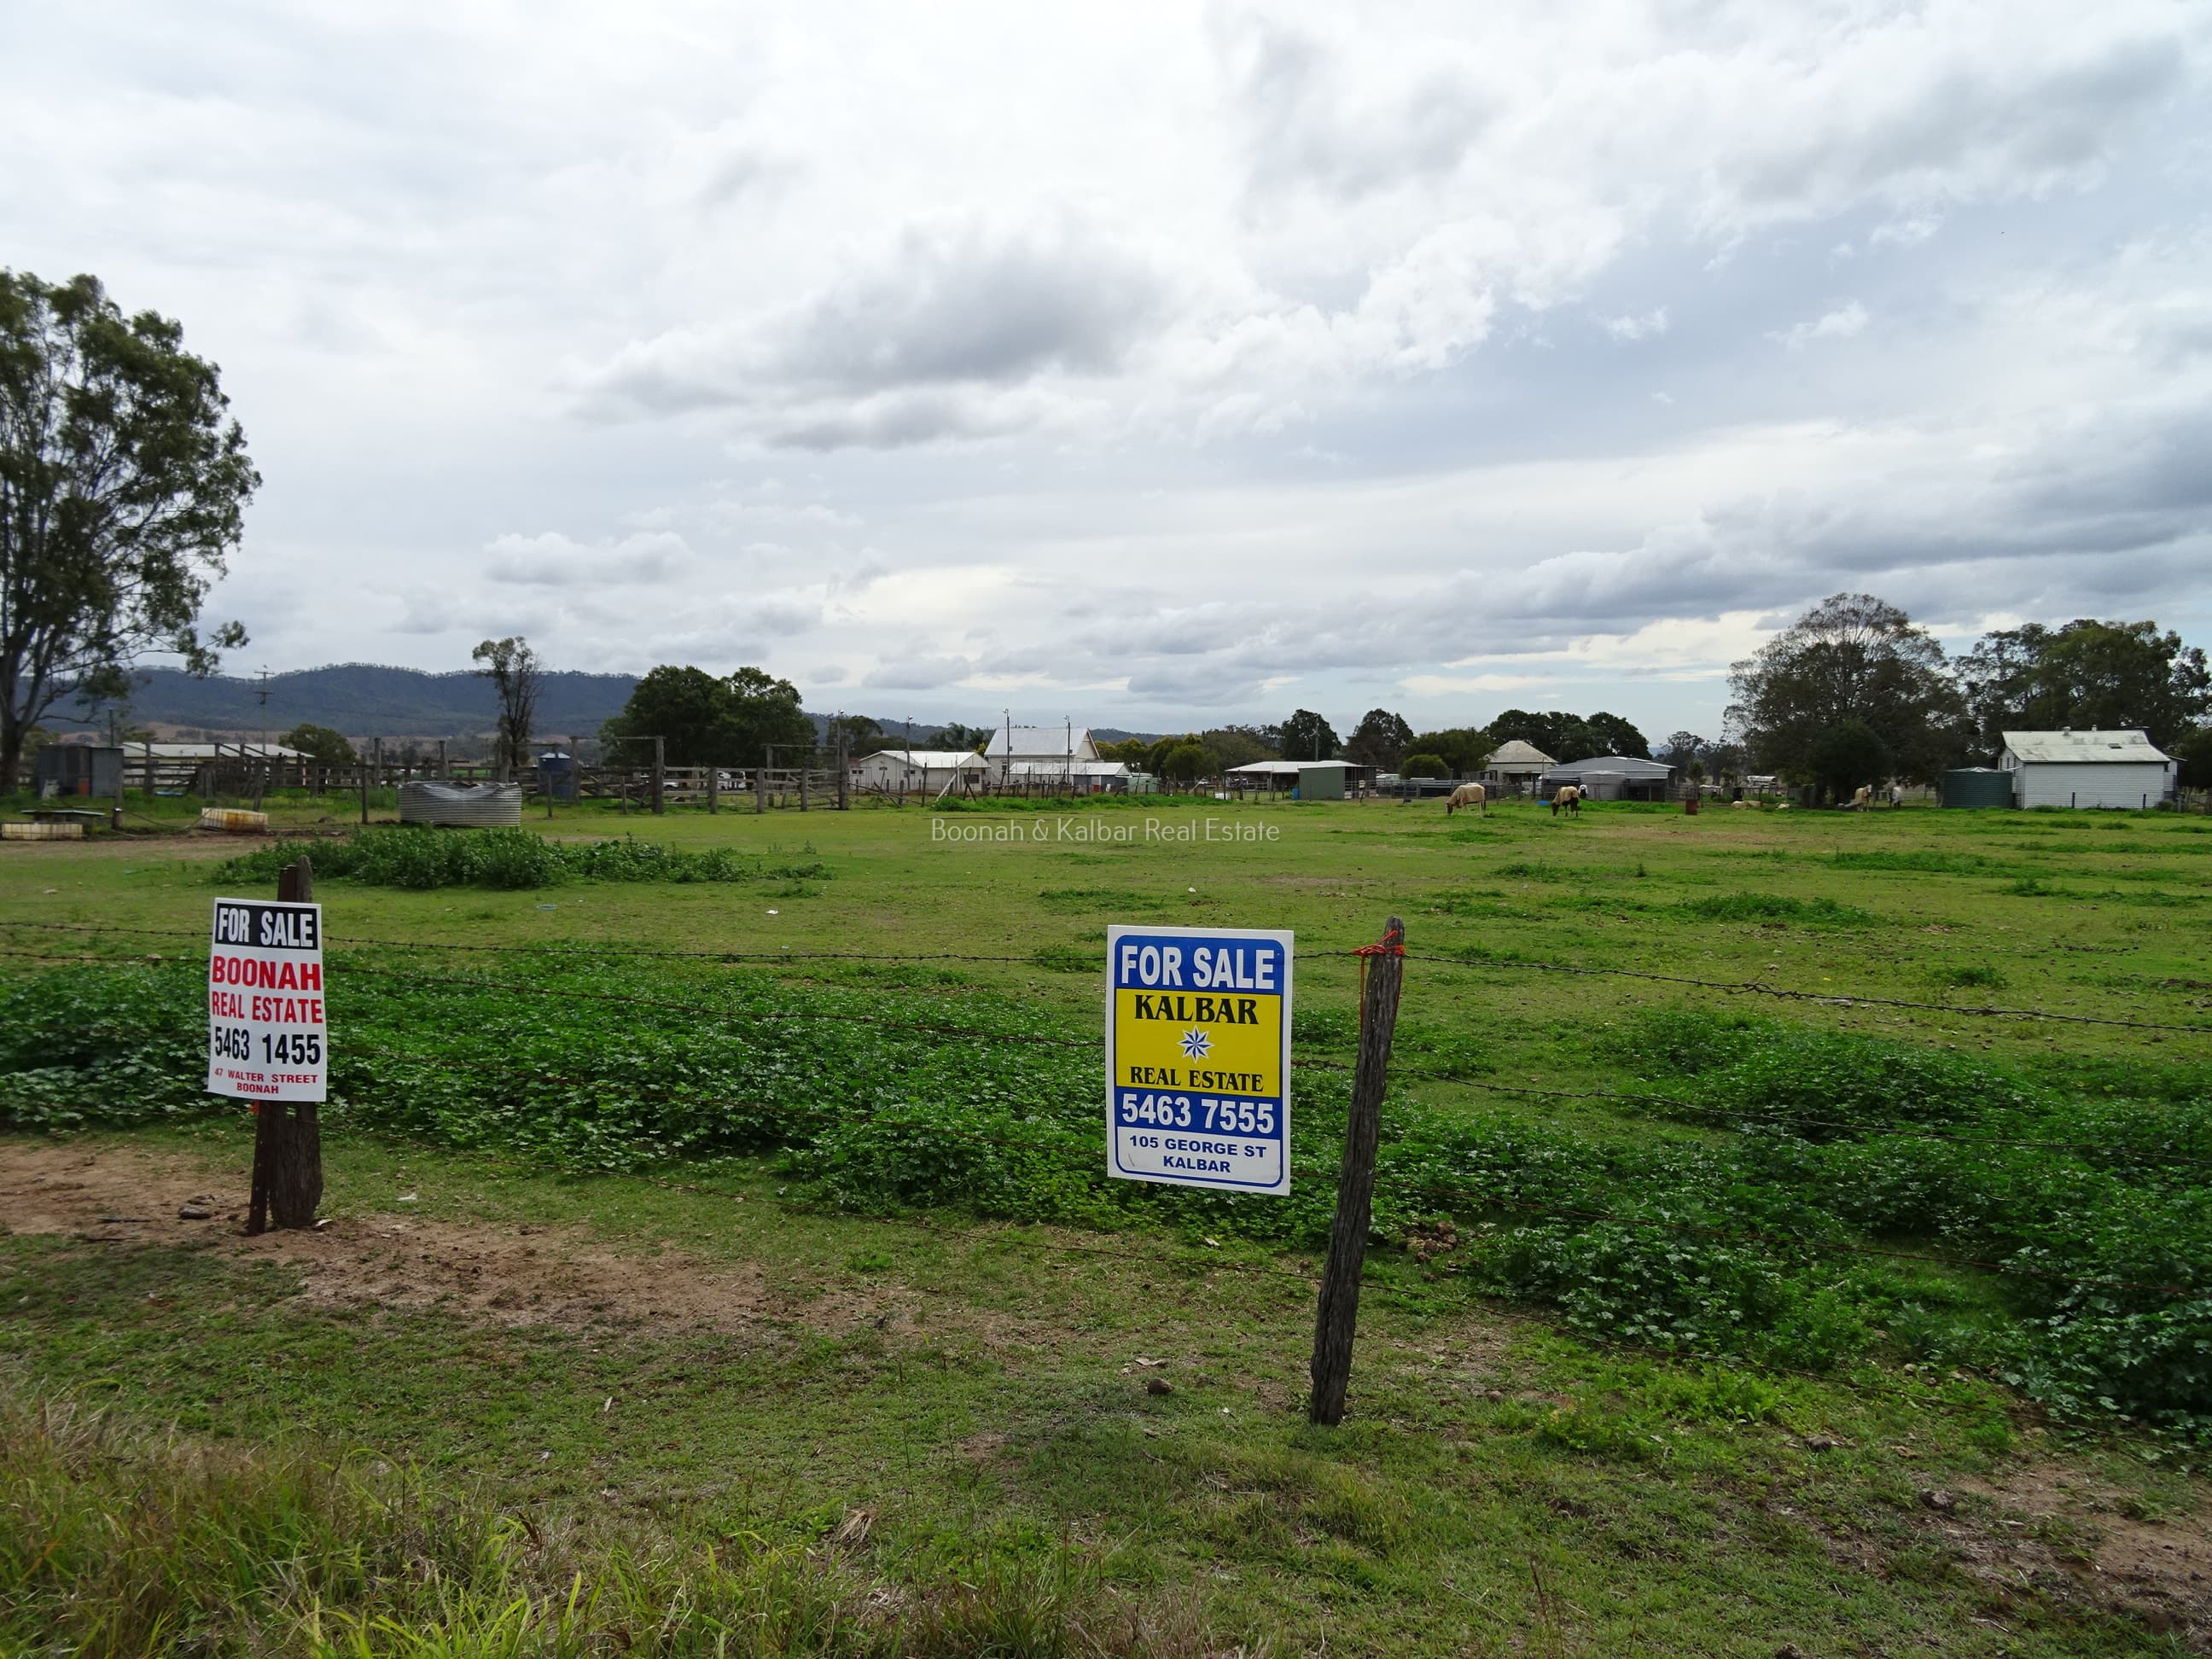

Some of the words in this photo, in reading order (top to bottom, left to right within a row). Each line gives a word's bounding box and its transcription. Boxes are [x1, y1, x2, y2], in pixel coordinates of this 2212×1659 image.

[218, 907, 250, 943] FOR
[260, 911, 313, 947] SALE
[212, 956, 321, 991] BOONAH
[1121, 946, 1183, 987] FOR
[1193, 947, 1275, 990] SALE
[212, 991, 245, 1019] REAL
[253, 996, 323, 1024] ESTATE
[1134, 994, 1259, 1025] KALBAR
[215, 1027, 249, 1061] 5463
[262, 1033, 321, 1065] 1455
[214, 1068, 224, 1077] 47
[228, 1069, 265, 1082] WALTER
[271, 1074, 318, 1084] STREET
[236, 1082, 279, 1094] BOONAH
[1130, 1066, 1181, 1086] REAL
[1189, 1069, 1264, 1092] ESTATE
[1122, 1093, 1191, 1127] 5463
[1201, 1098, 1274, 1134] 7555
[1129, 1135, 1159, 1150] 105
[1164, 1138, 1237, 1155] GEORGE
[1243, 1145, 1267, 1158] ST
[1163, 1155, 1231, 1173] KALBAR
